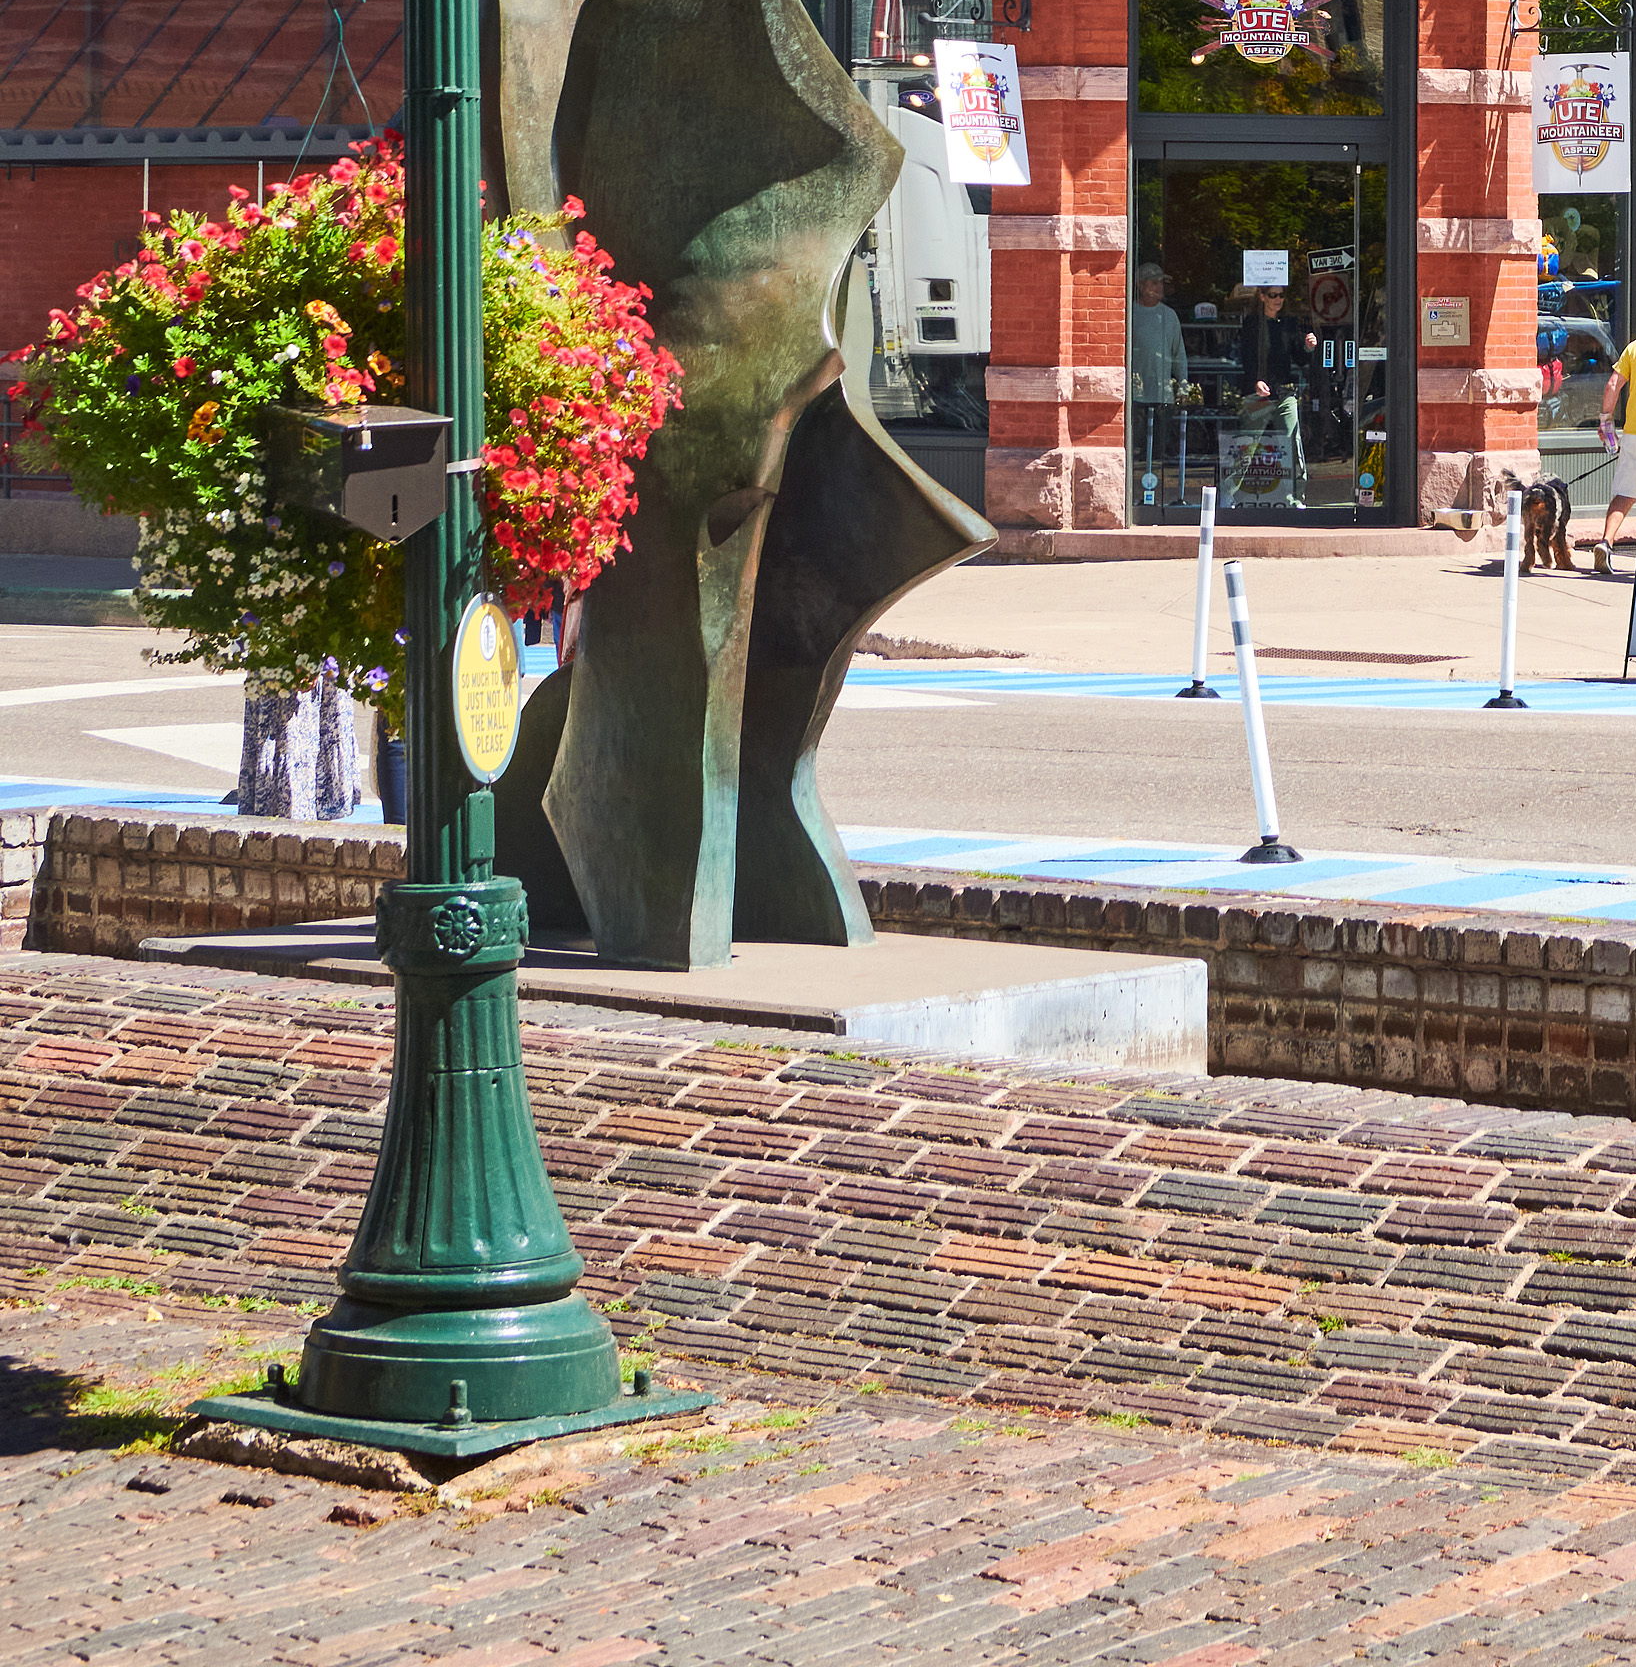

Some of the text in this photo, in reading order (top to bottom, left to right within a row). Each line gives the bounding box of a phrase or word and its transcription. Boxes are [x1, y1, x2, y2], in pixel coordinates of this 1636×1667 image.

[1241, 11, 1287, 28] UTE
[1223, 33, 1306, 42] MOUNTAINEER
[1246, 47, 1283, 55] ASPEN
[963, 90, 1000, 112] UTE
[1558, 101, 1600, 121] UTE
[951, 114, 1018, 130] MOUNTAINEER
[1540, 126, 1621, 140] MOUNTAINEER
[1563, 146, 1596, 155] ASPEN
[462, 674, 470, 688] SO
[471, 672, 489, 687] MUCH
[491, 671, 498, 686] TO
[465, 689, 513, 711] JUST NOT ON
[470, 711, 509, 733] THE MALL,
[476, 734, 504, 754] PLEASE
